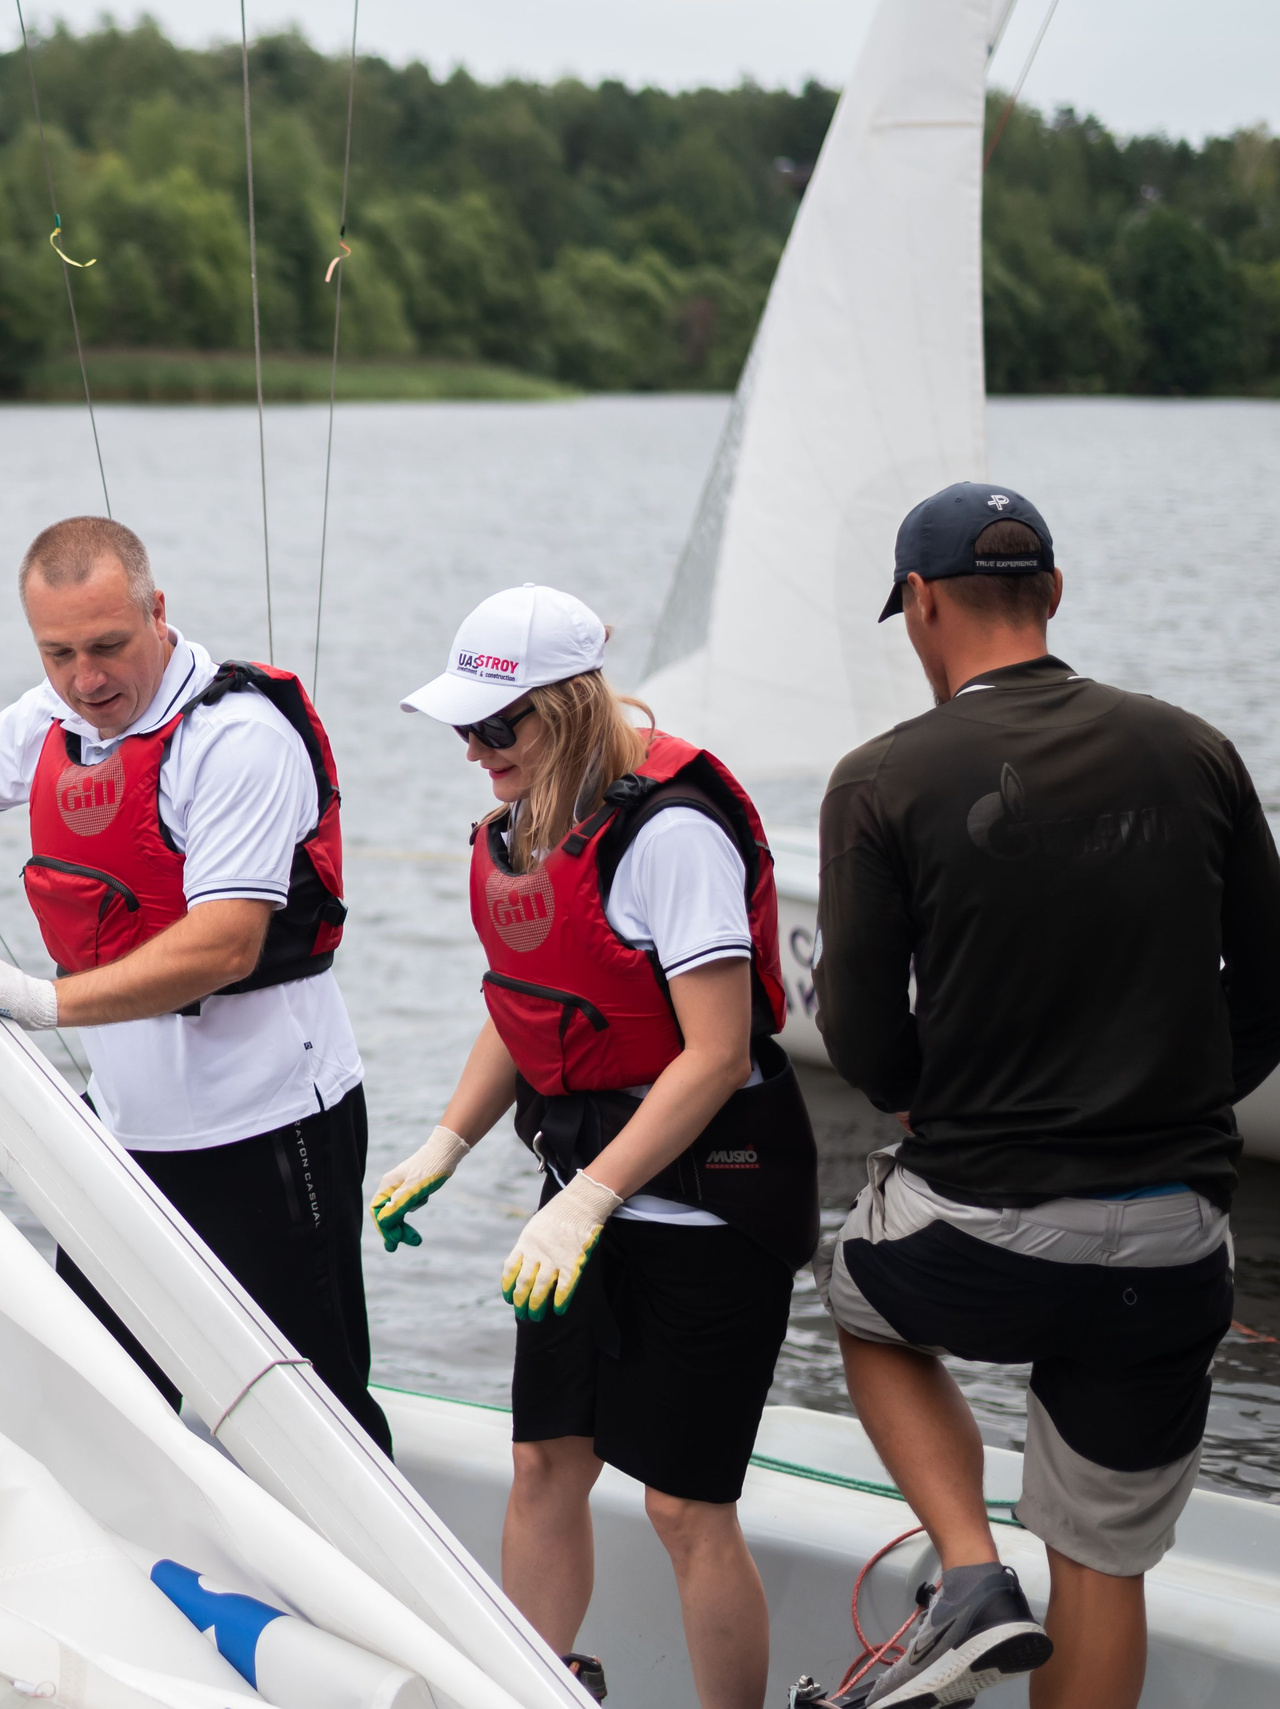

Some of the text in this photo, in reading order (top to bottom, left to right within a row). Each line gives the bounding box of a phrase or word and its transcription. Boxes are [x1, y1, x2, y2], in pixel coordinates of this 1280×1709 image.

[975, 560, 1038, 568] TRUE EXPERIENCE
[485, 672, 516, 682] construction
[61, 776, 116, 812] Gill
[492, 889, 548, 927] Gill
[706, 1150, 758, 1163] MUSTO
